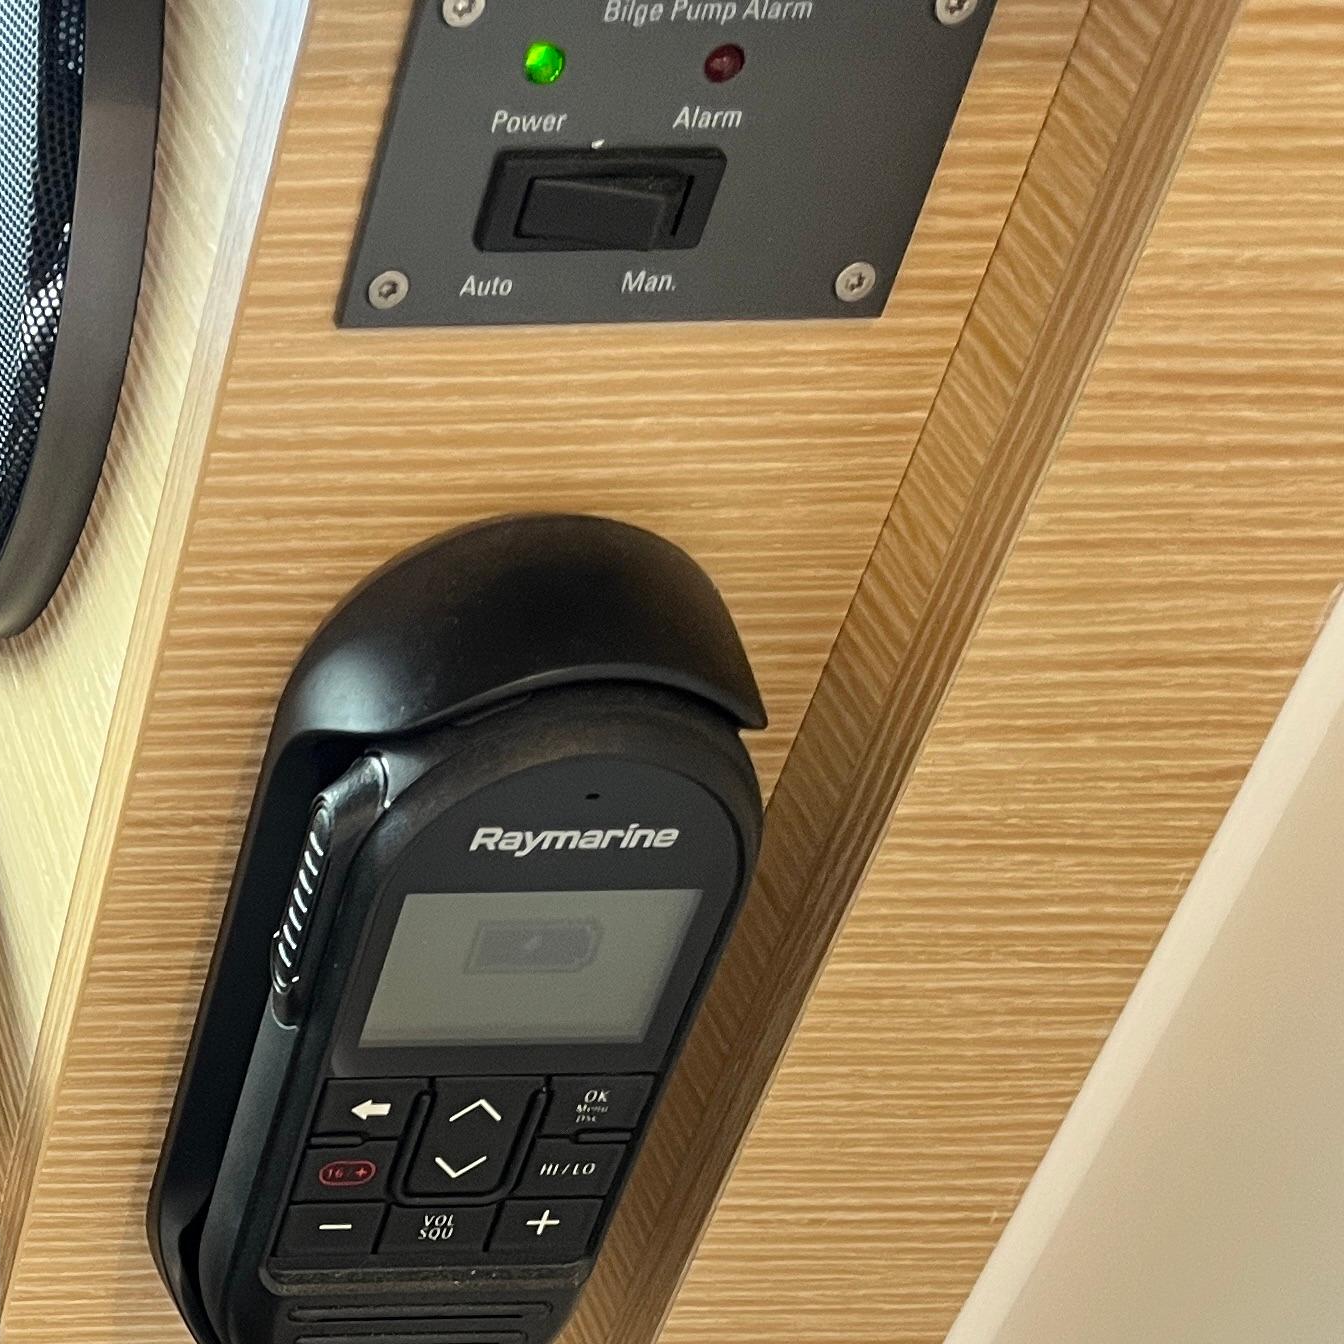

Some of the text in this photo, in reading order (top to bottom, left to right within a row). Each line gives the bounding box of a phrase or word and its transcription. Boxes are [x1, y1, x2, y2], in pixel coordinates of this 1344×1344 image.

[603, 0, 813, 27] Bilge Pump Alarm
[491, 109, 568, 133] Power
[672, 105, 743, 130] Alarm
[459, 274, 513, 297] Auto
[621, 270, 677, 293] Man.
[469, 823, 680, 857] Raymarine
[584, 1090, 611, 1103] OK
[424, 1214, 454, 1227] VOL
[417, 1227, 454, 1241] SQU
